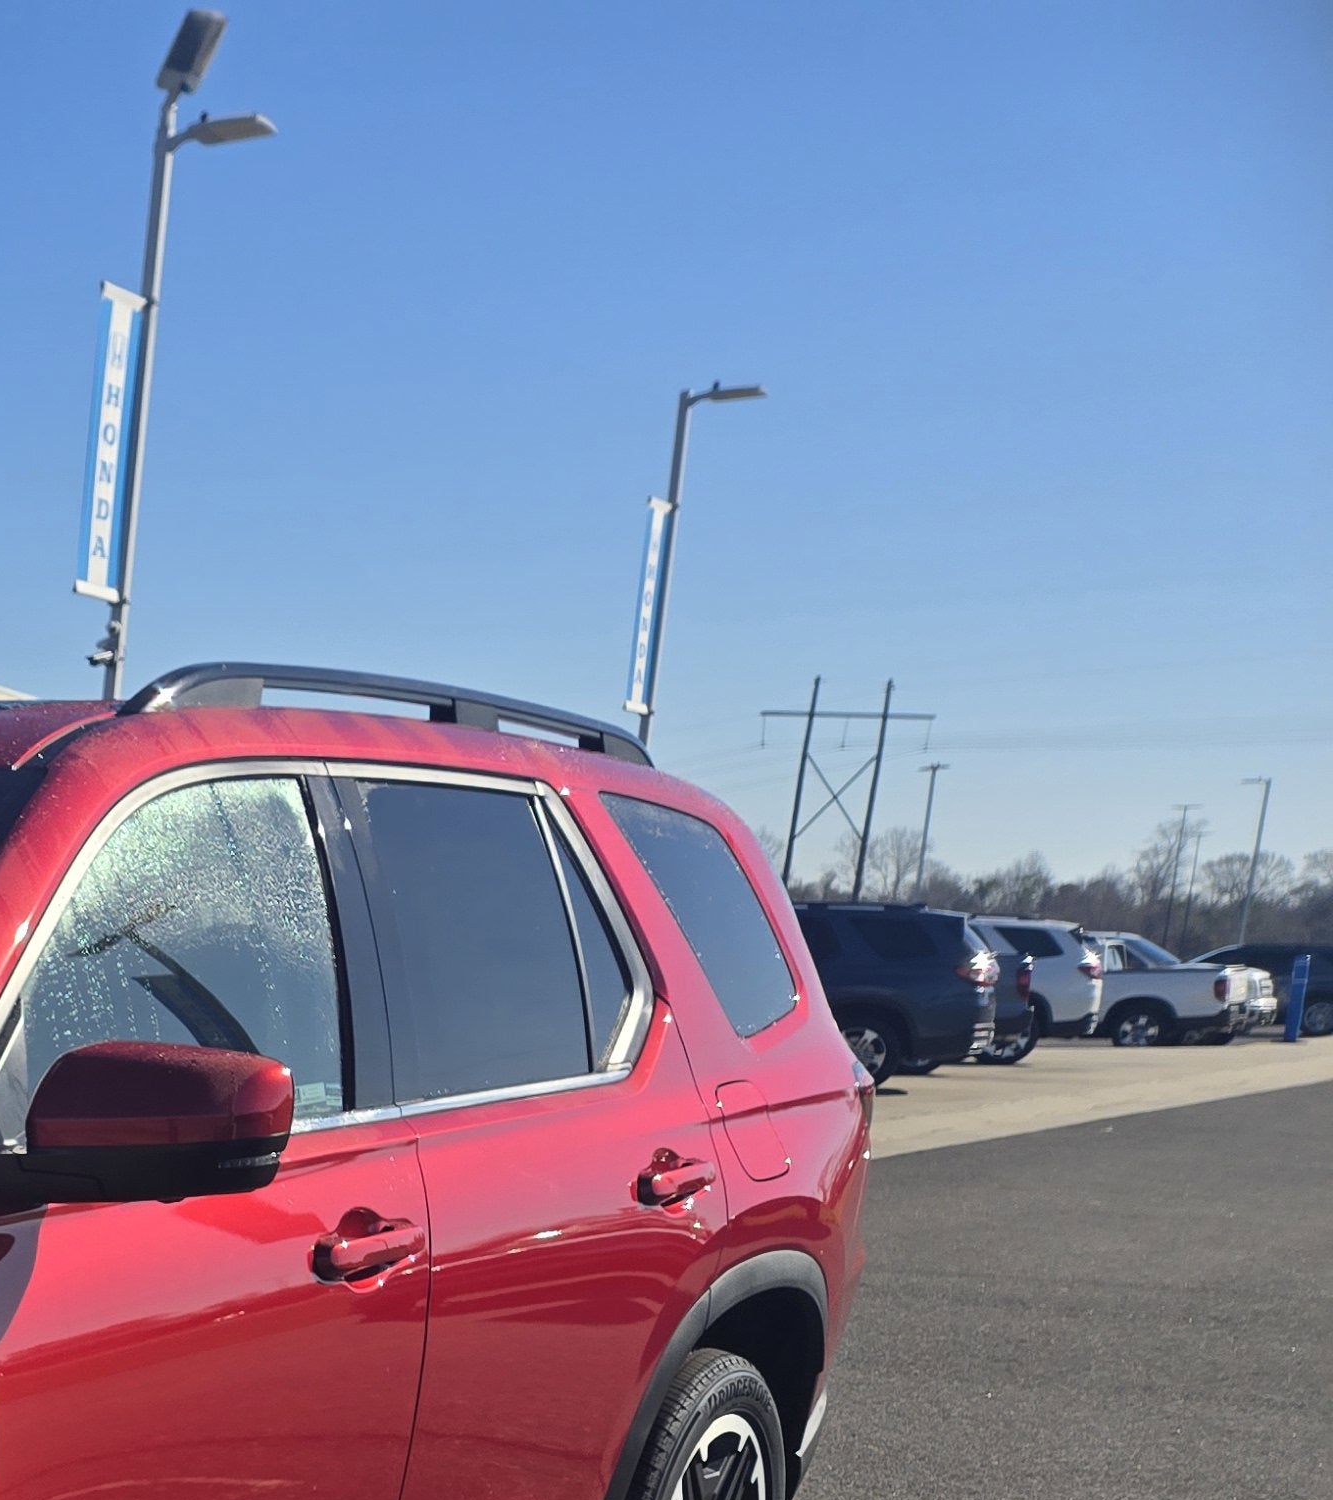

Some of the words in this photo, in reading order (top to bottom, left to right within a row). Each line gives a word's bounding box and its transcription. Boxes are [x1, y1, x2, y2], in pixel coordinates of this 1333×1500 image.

[91, 382, 122, 560] HONDA
[634, 563, 656, 684] HONDA
[706, 1375, 772, 1415] BRIDGESTONE
